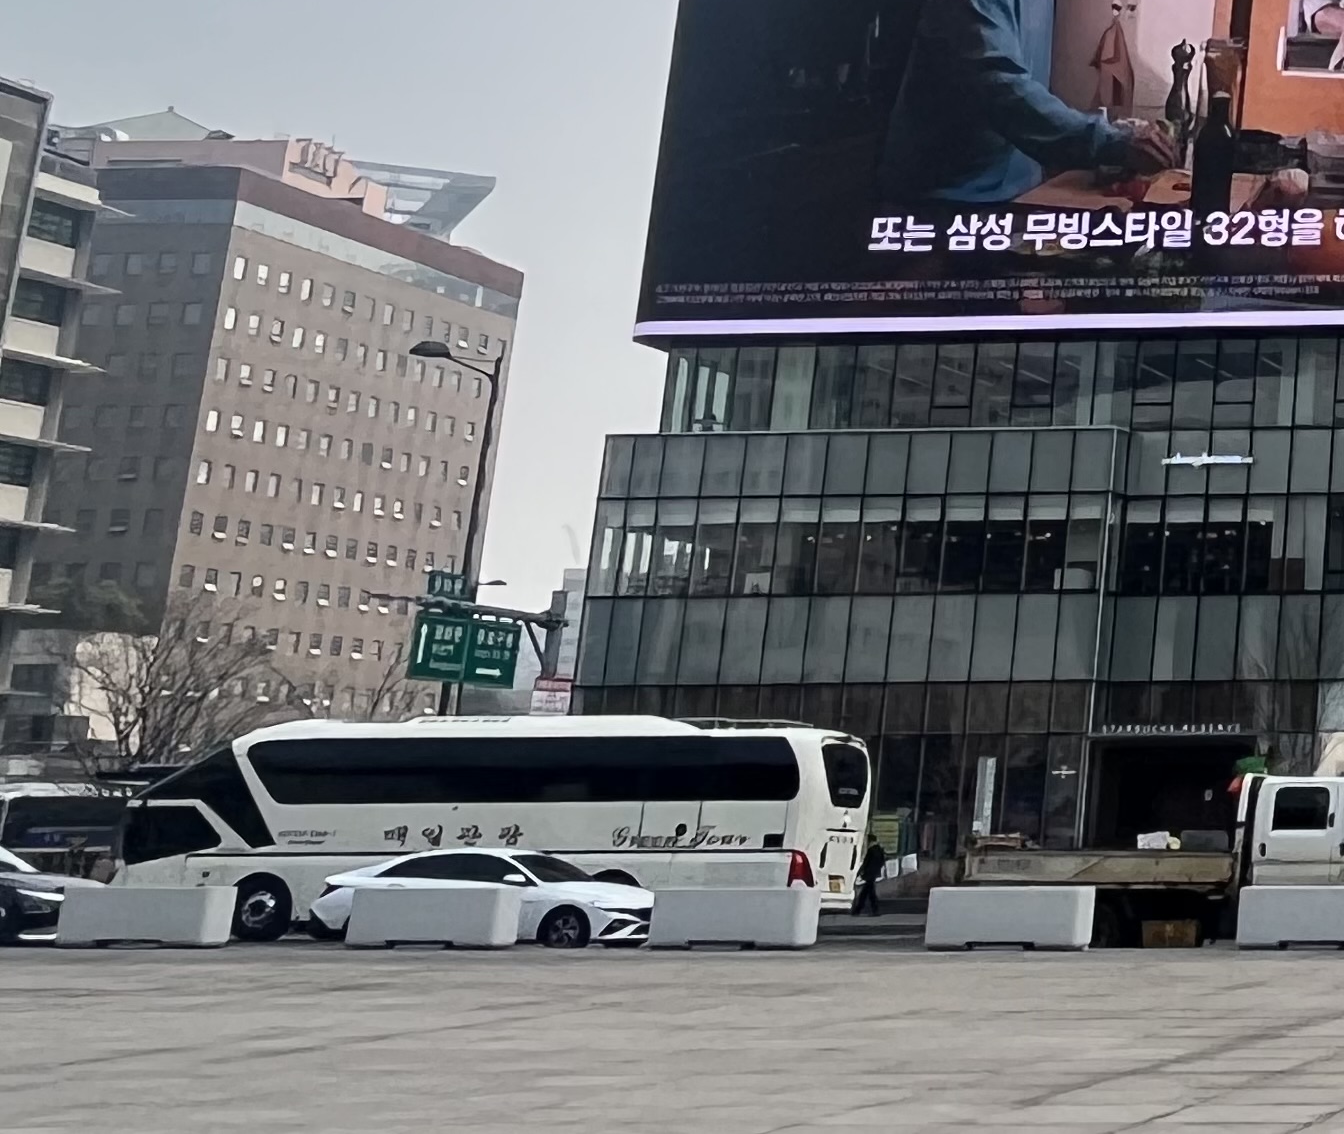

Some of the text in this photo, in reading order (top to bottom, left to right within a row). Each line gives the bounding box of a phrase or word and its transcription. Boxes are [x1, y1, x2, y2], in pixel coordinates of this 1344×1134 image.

[868, 215, 936, 252] 또는
[946, 213, 1013, 251] 삼성
[1022, 209, 1194, 251] 무빙스타일
[1203, 208, 1324, 247] 32형을
